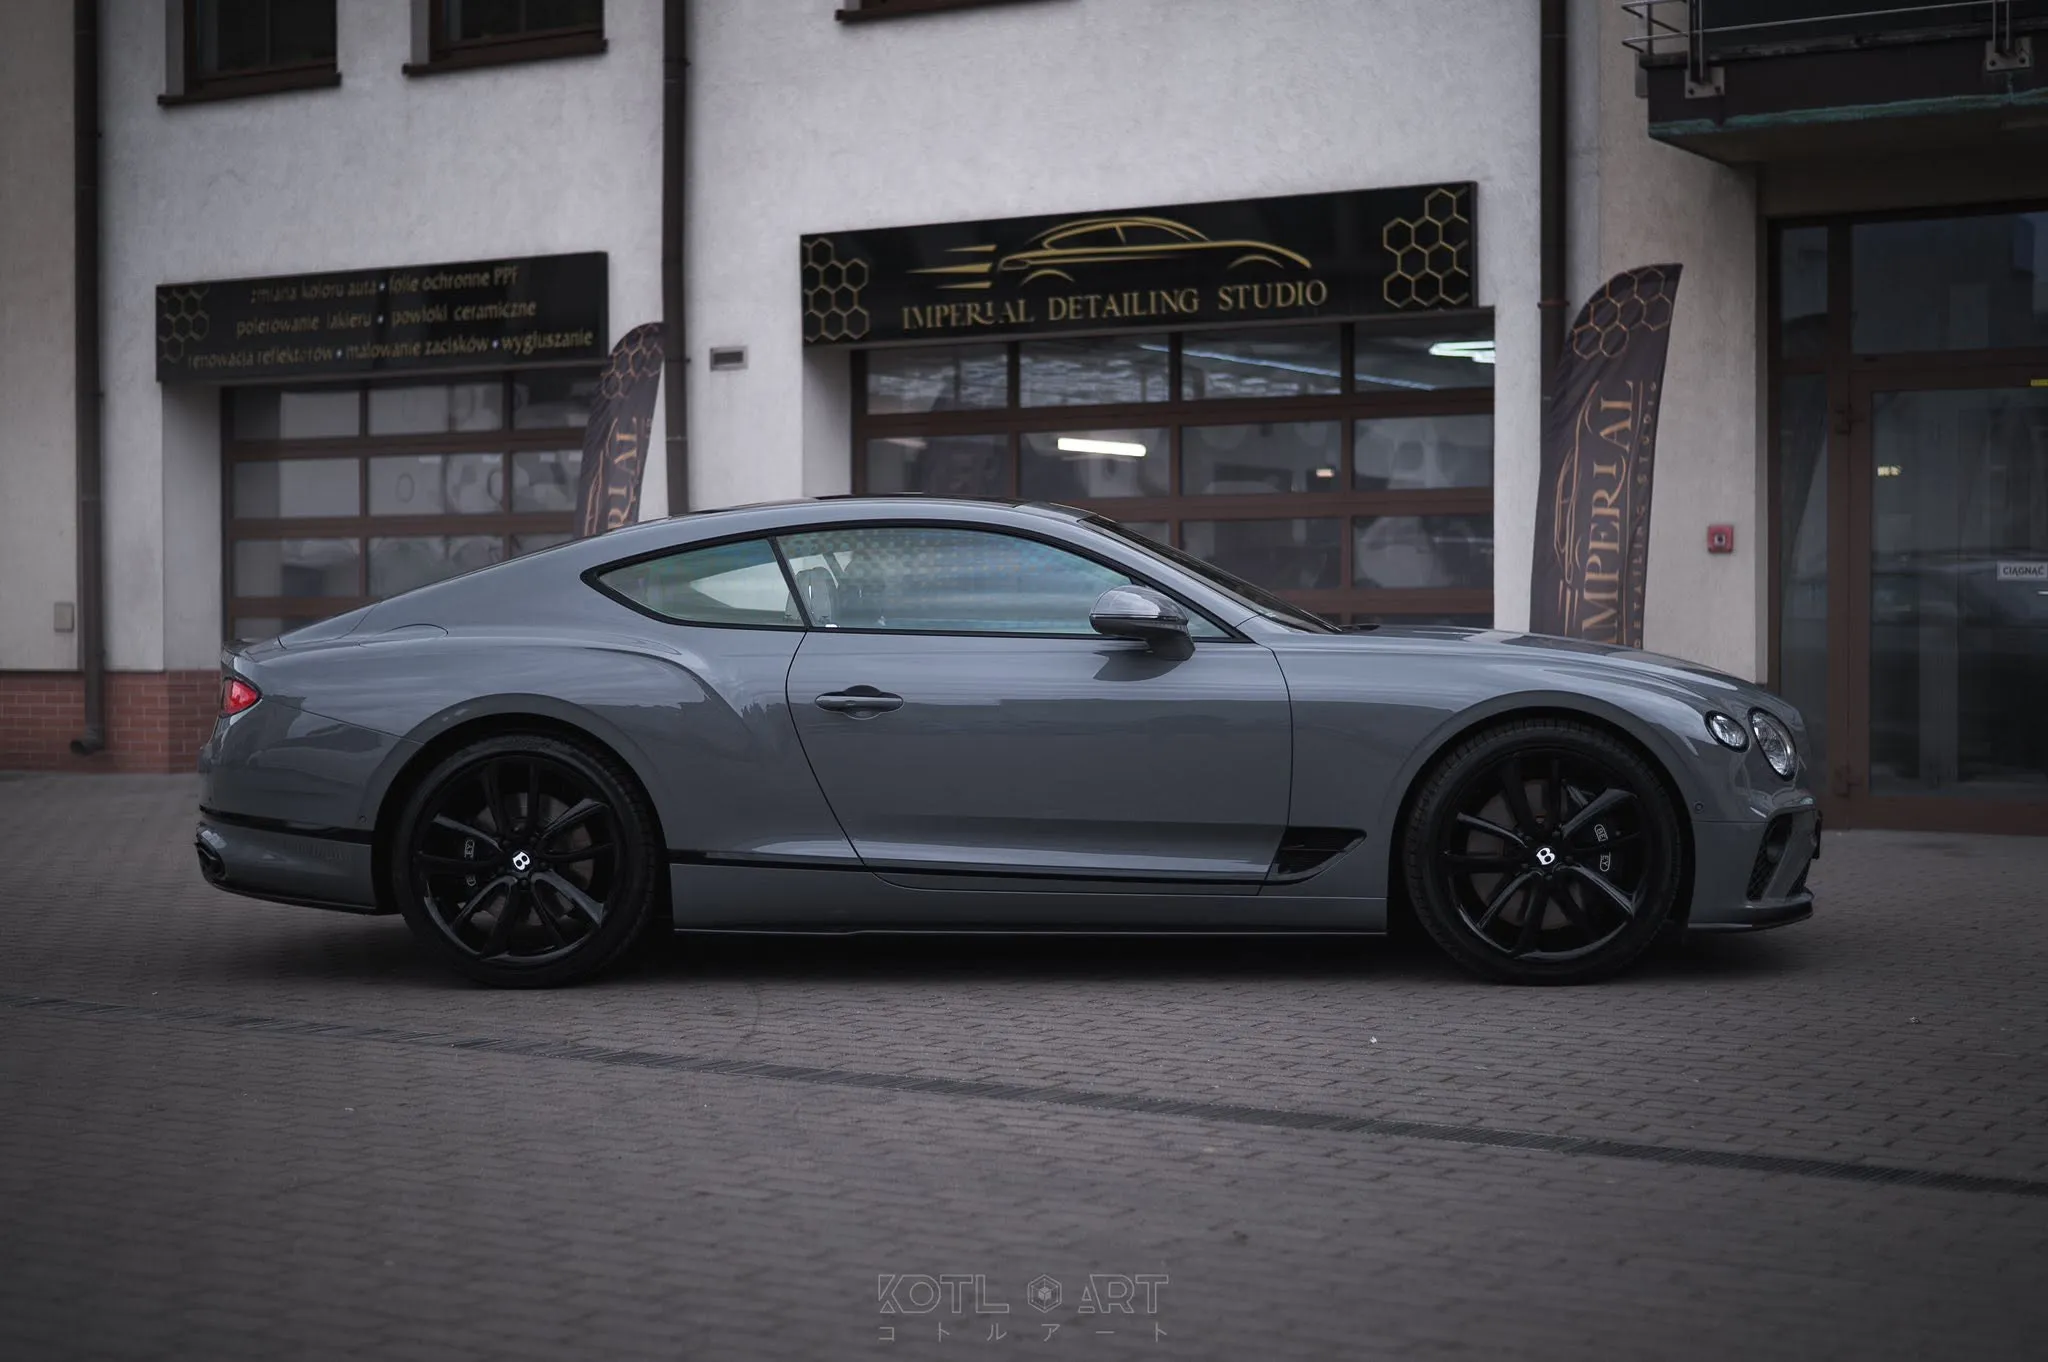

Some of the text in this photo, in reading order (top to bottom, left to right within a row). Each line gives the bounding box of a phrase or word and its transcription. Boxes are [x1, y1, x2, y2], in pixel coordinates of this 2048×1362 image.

[302, 282, 344, 300] koloru
[347, 281, 377, 297] auta
[389, 272, 419, 296] folie
[422, 270, 490, 291] ochronne
[493, 266, 519, 286] PPF
[236, 314, 320, 339] polerowanie
[327, 312, 372, 330] lakieru
[453, 299, 537, 322] ceramiczne
[901, 279, 1328, 331] IMPERIAL DETAILING STUDIO
[187, 351, 254, 371] renowacja
[346, 341, 420, 361] malowanie
[424, 337, 489, 356] zacisków
[511, 850, 531, 871] B
[1535, 847, 1556, 866] B
